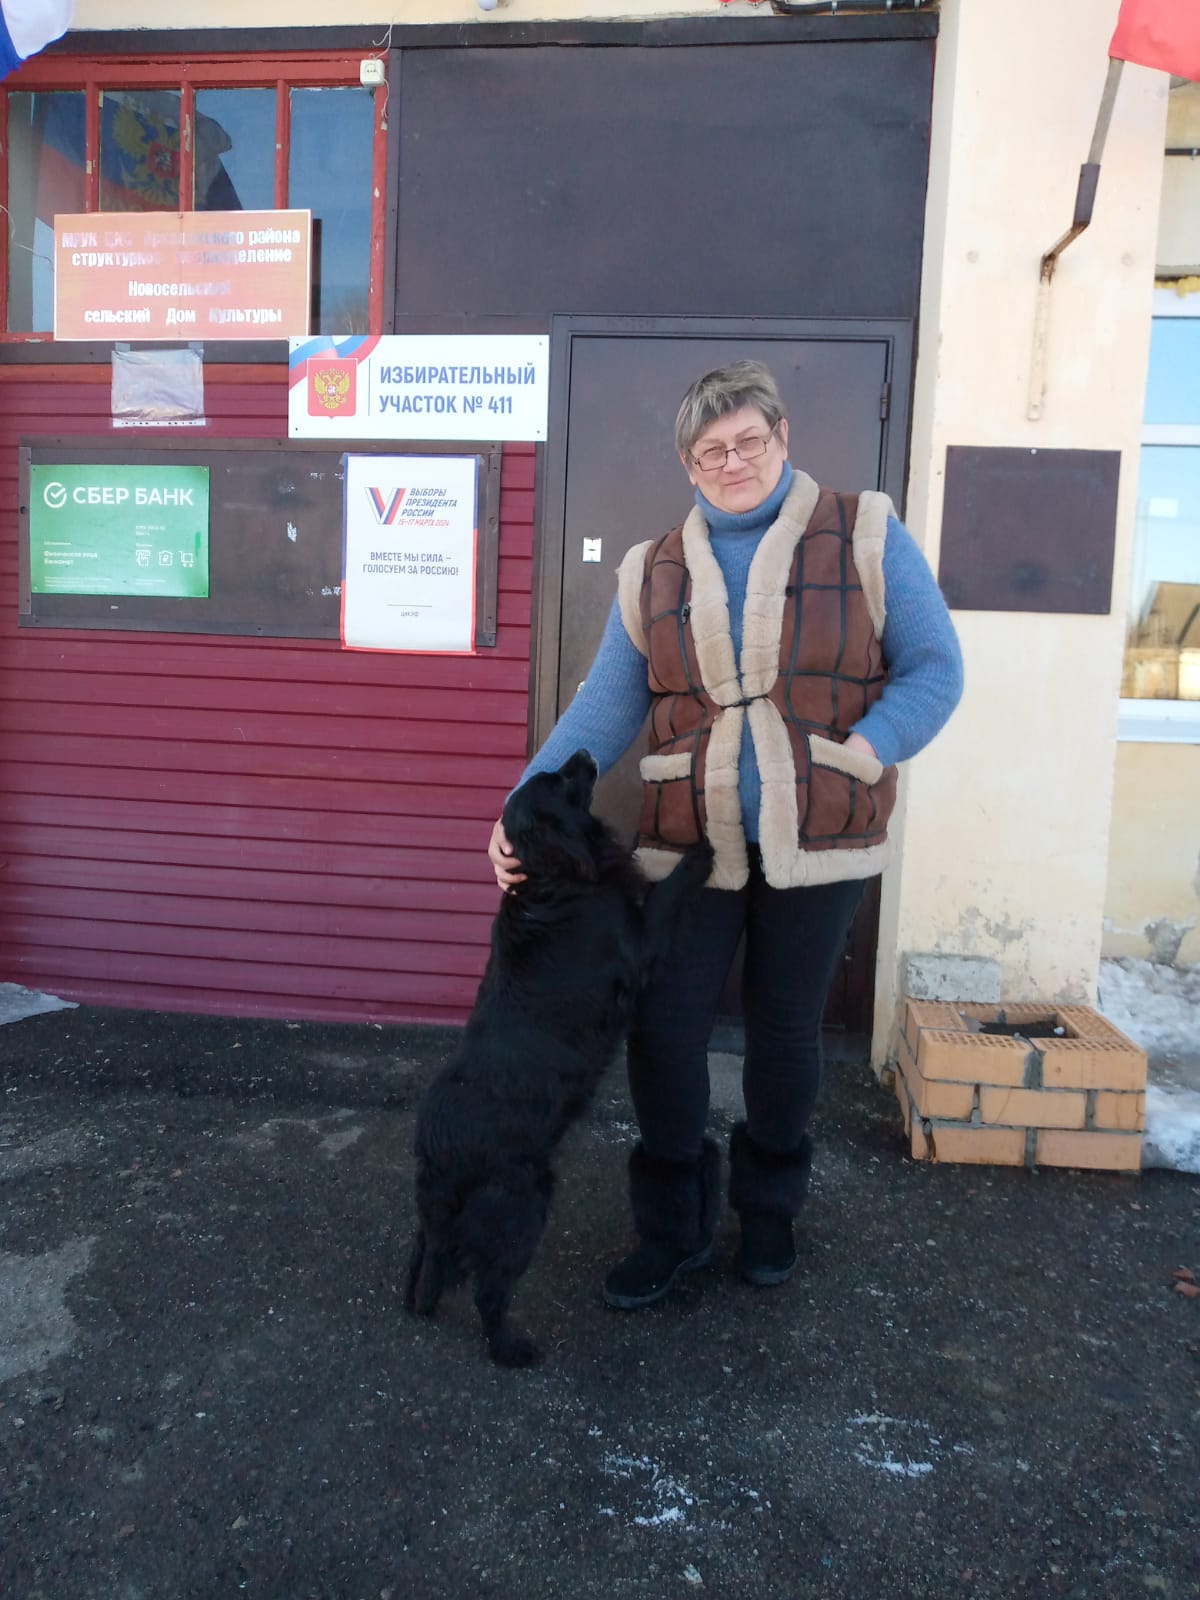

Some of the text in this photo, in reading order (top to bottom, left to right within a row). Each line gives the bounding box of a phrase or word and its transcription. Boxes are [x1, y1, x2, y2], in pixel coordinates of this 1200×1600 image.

[248, 227, 300, 245] района
[84, 307, 151, 324] сельский
[165, 308, 197, 326] Дом
[379, 361, 536, 385] ИЗБИРАТЕЛЬНЫЙ
[379, 395, 513, 414] УЧАСТОК № 411
[73, 487, 193, 506] СБЕР БАНК
[409, 488, 447, 497] ВЫБОРЫ
[405, 499, 458, 508] ПРЕЗИДЕНТА
[401, 509, 435, 517] РОССИИ
[370, 552, 402, 562] ВМЕСТЕ
[403, 552, 419, 562] МЫ
[420, 553, 444, 563] СИЛА
[362, 564, 459, 576] ГОЛОСУЕМ ЗА РОССИЮ!
